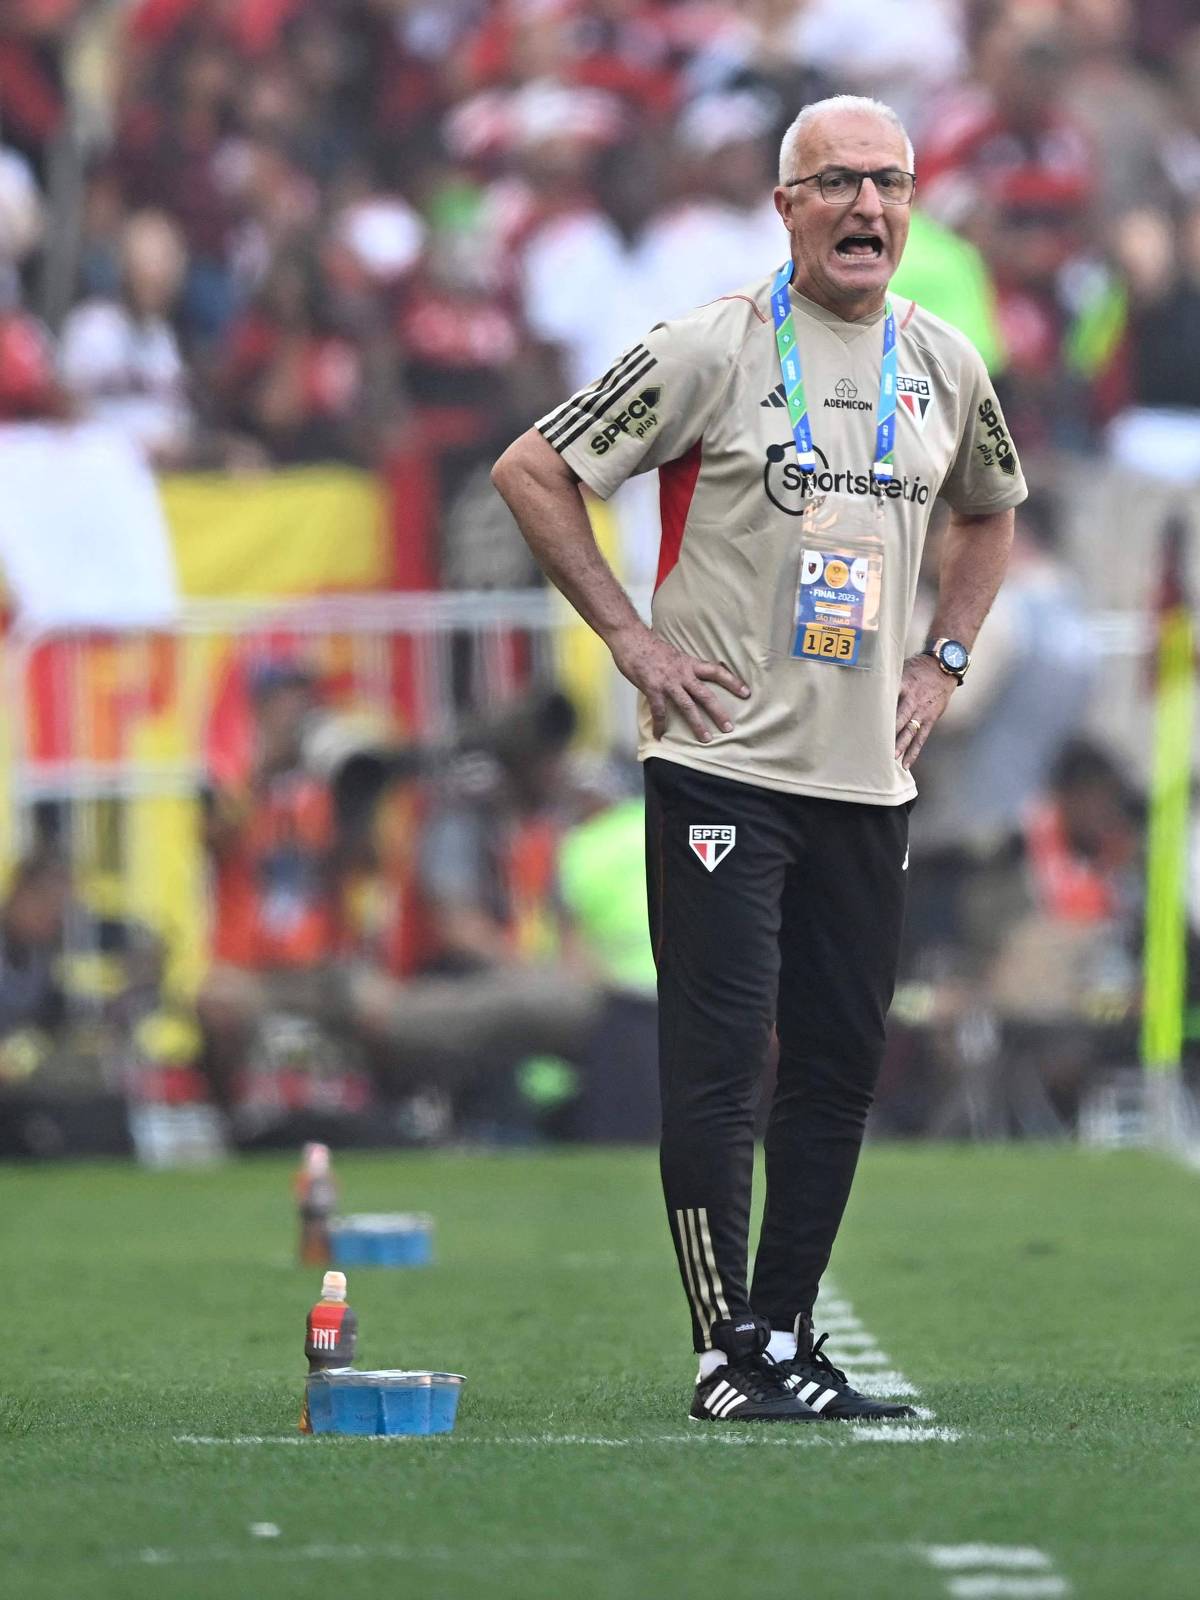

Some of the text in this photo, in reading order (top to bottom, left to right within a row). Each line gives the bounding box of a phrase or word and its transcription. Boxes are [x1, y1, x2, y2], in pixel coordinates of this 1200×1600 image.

[897, 378, 927, 395] SPFC
[823, 398, 873, 411] ADEMICON
[590, 400, 648, 455] SPFC
[636, 414, 658, 438] play
[978, 398, 1010, 458] SPFC
[977, 443, 995, 466] play
[813, 589, 856, 602] FINAL 2023
[807, 634, 851, 655] 1 2 3
[693, 829, 731, 840] SPFC
[312, 1328, 339, 1350] TNT
